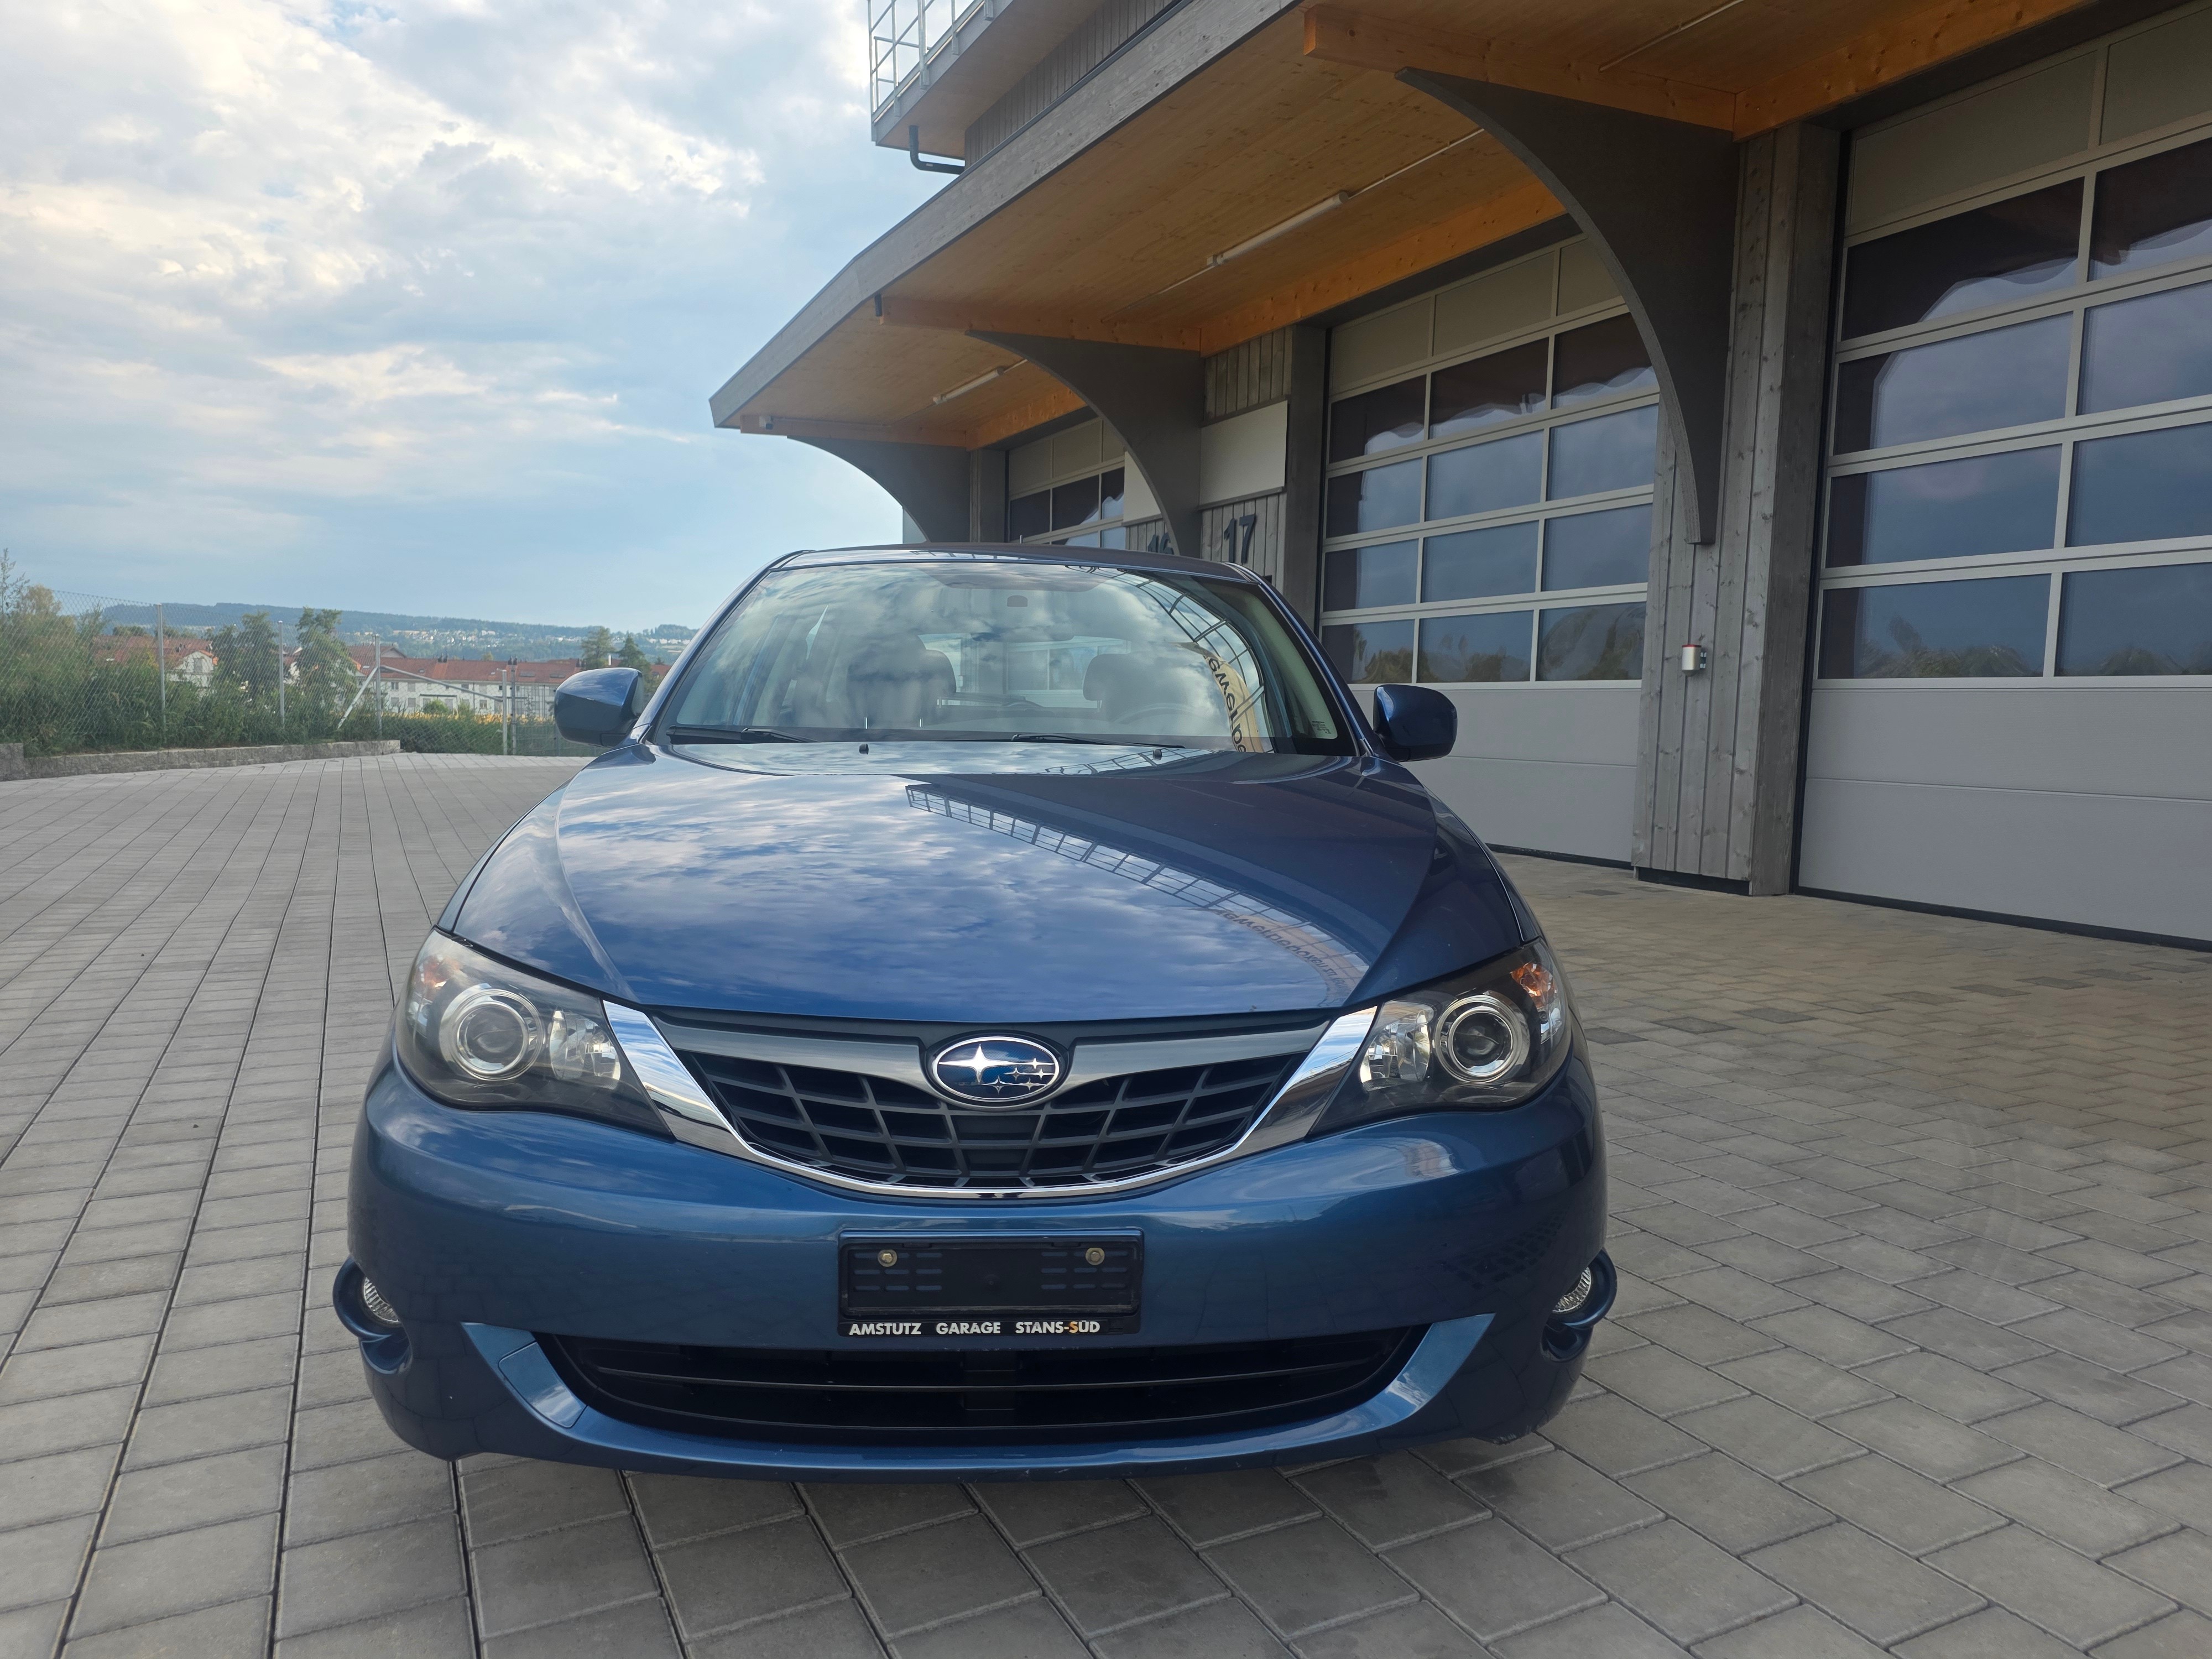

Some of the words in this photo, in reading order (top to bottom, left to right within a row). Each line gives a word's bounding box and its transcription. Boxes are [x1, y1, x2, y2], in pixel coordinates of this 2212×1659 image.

[1224, 514, 1256, 564] 17
[849, 1322, 922, 1335] AMSTUTZ
[936, 1322, 1001, 1334] GARAGE
[1015, 1320, 1100, 1334] STANS-SÜD
